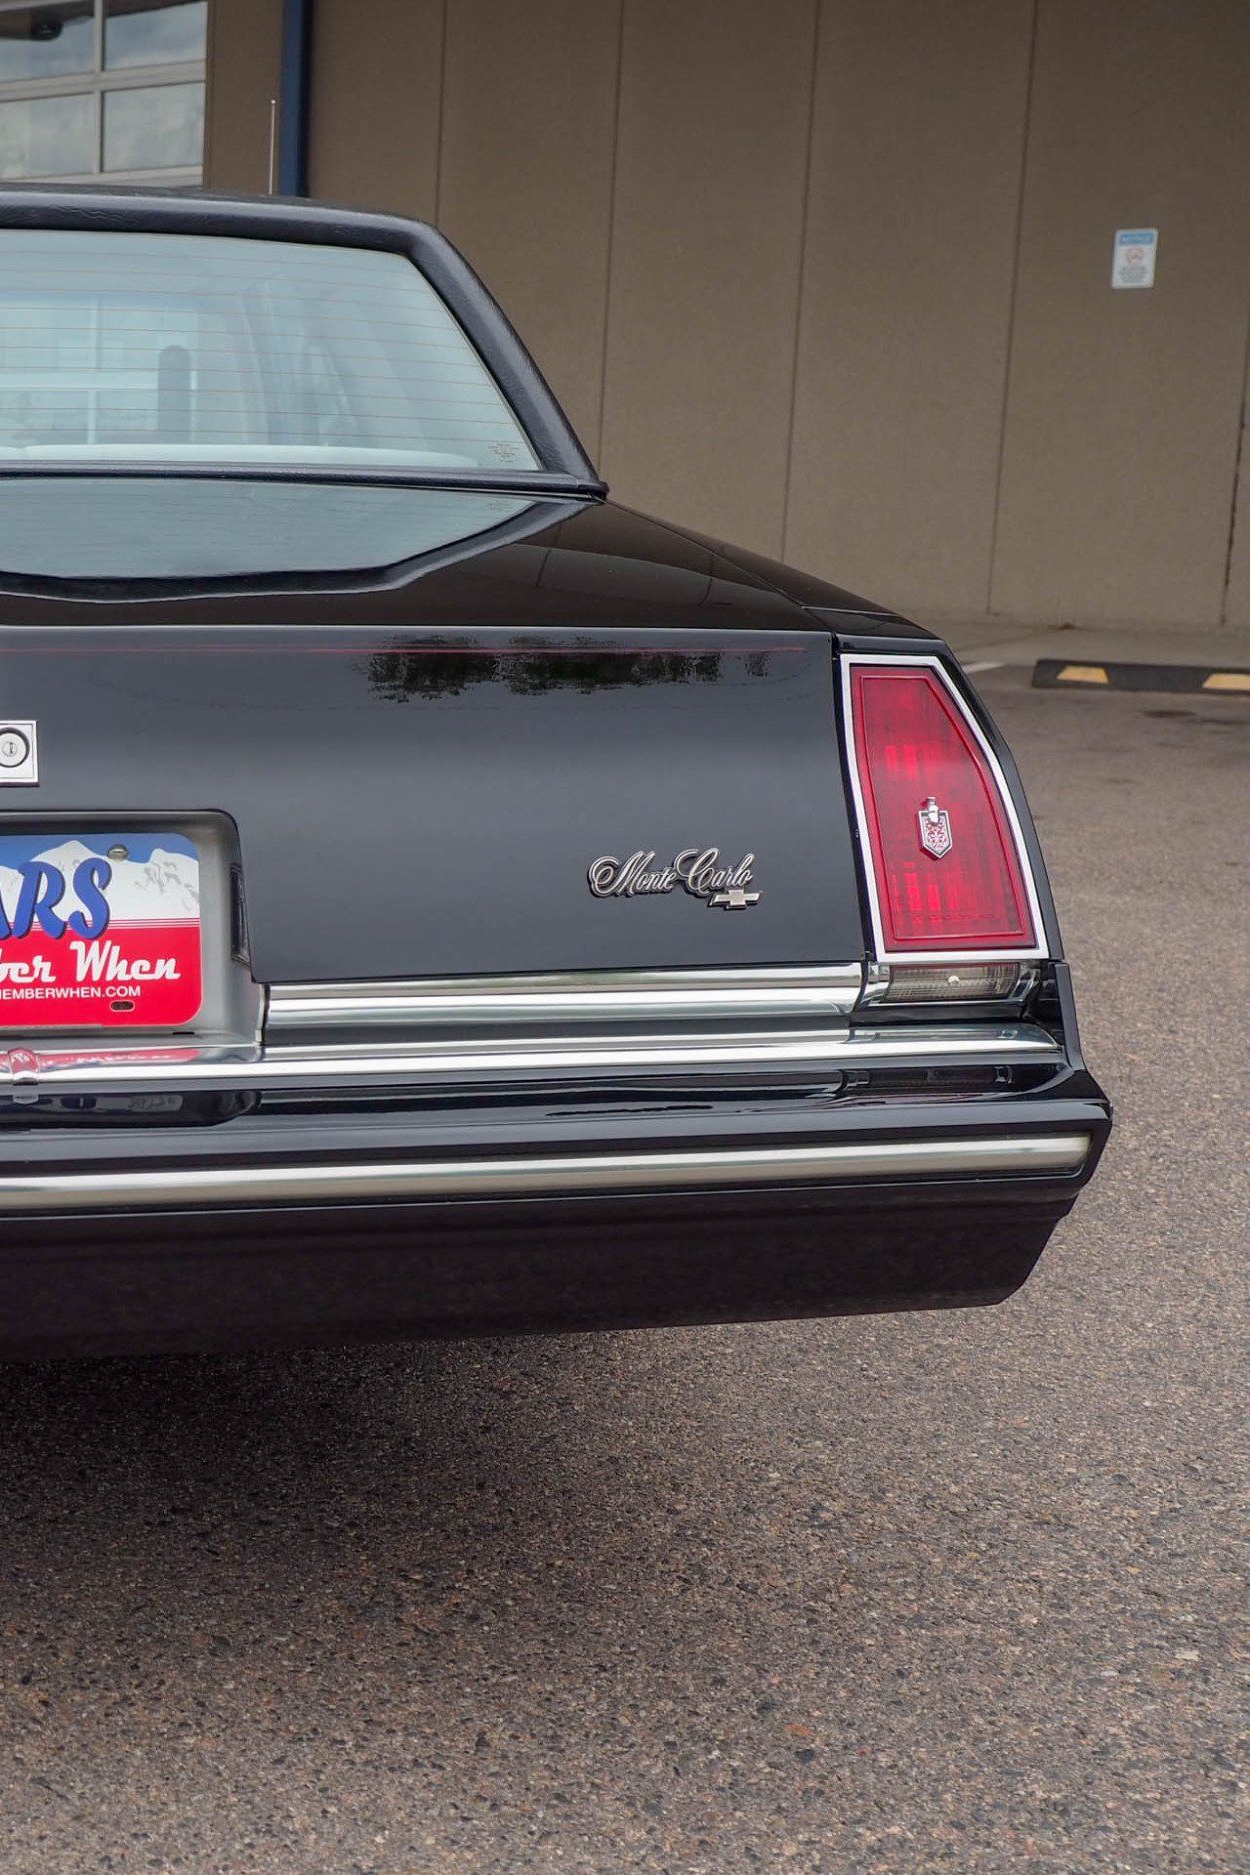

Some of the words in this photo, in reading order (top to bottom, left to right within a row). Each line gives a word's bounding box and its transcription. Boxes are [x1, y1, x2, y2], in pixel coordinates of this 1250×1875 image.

[589, 850, 677, 897] Monte
[674, 847, 755, 895] Carlo
[69, 940, 181, 981] When
